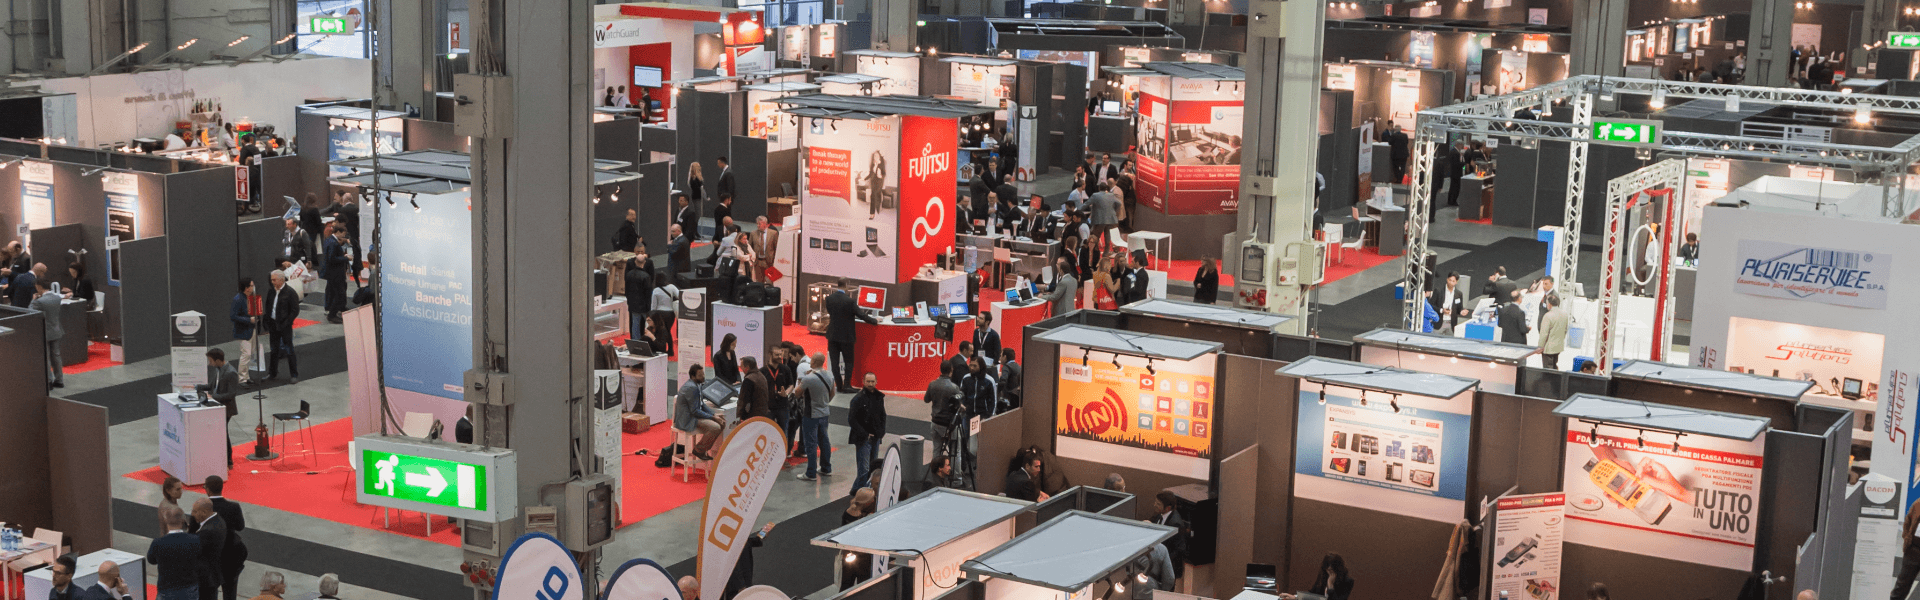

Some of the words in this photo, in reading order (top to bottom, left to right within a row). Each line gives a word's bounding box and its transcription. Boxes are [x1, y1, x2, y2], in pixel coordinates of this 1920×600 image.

[595, 28, 640, 41] WatchGuard
[867, 121, 891, 132] FUJITSU
[827, 152, 847, 160] through
[833, 160, 849, 168] world
[818, 167, 848, 177] productivity
[909, 150, 950, 182] FUJITSU
[400, 262, 427, 276] Retail
[1741, 258, 1871, 289] PLURISERVICE
[418, 279, 446, 291] Umane
[415, 291, 452, 307] Banche
[888, 341, 947, 363] FUJITSU
[1765, 344, 1851, 365] Solutions
[1083, 405, 1110, 430] IN
[1701, 453, 1722, 462] CASSA
[1723, 456, 1755, 467] PALMARE
[728, 434, 767, 507] NORD
[739, 440, 776, 511] ELETTRONICA
[1693, 487, 1753, 515] TUTTO
[1693, 507, 1704, 519] IN
[1709, 511, 1750, 534] UNO
